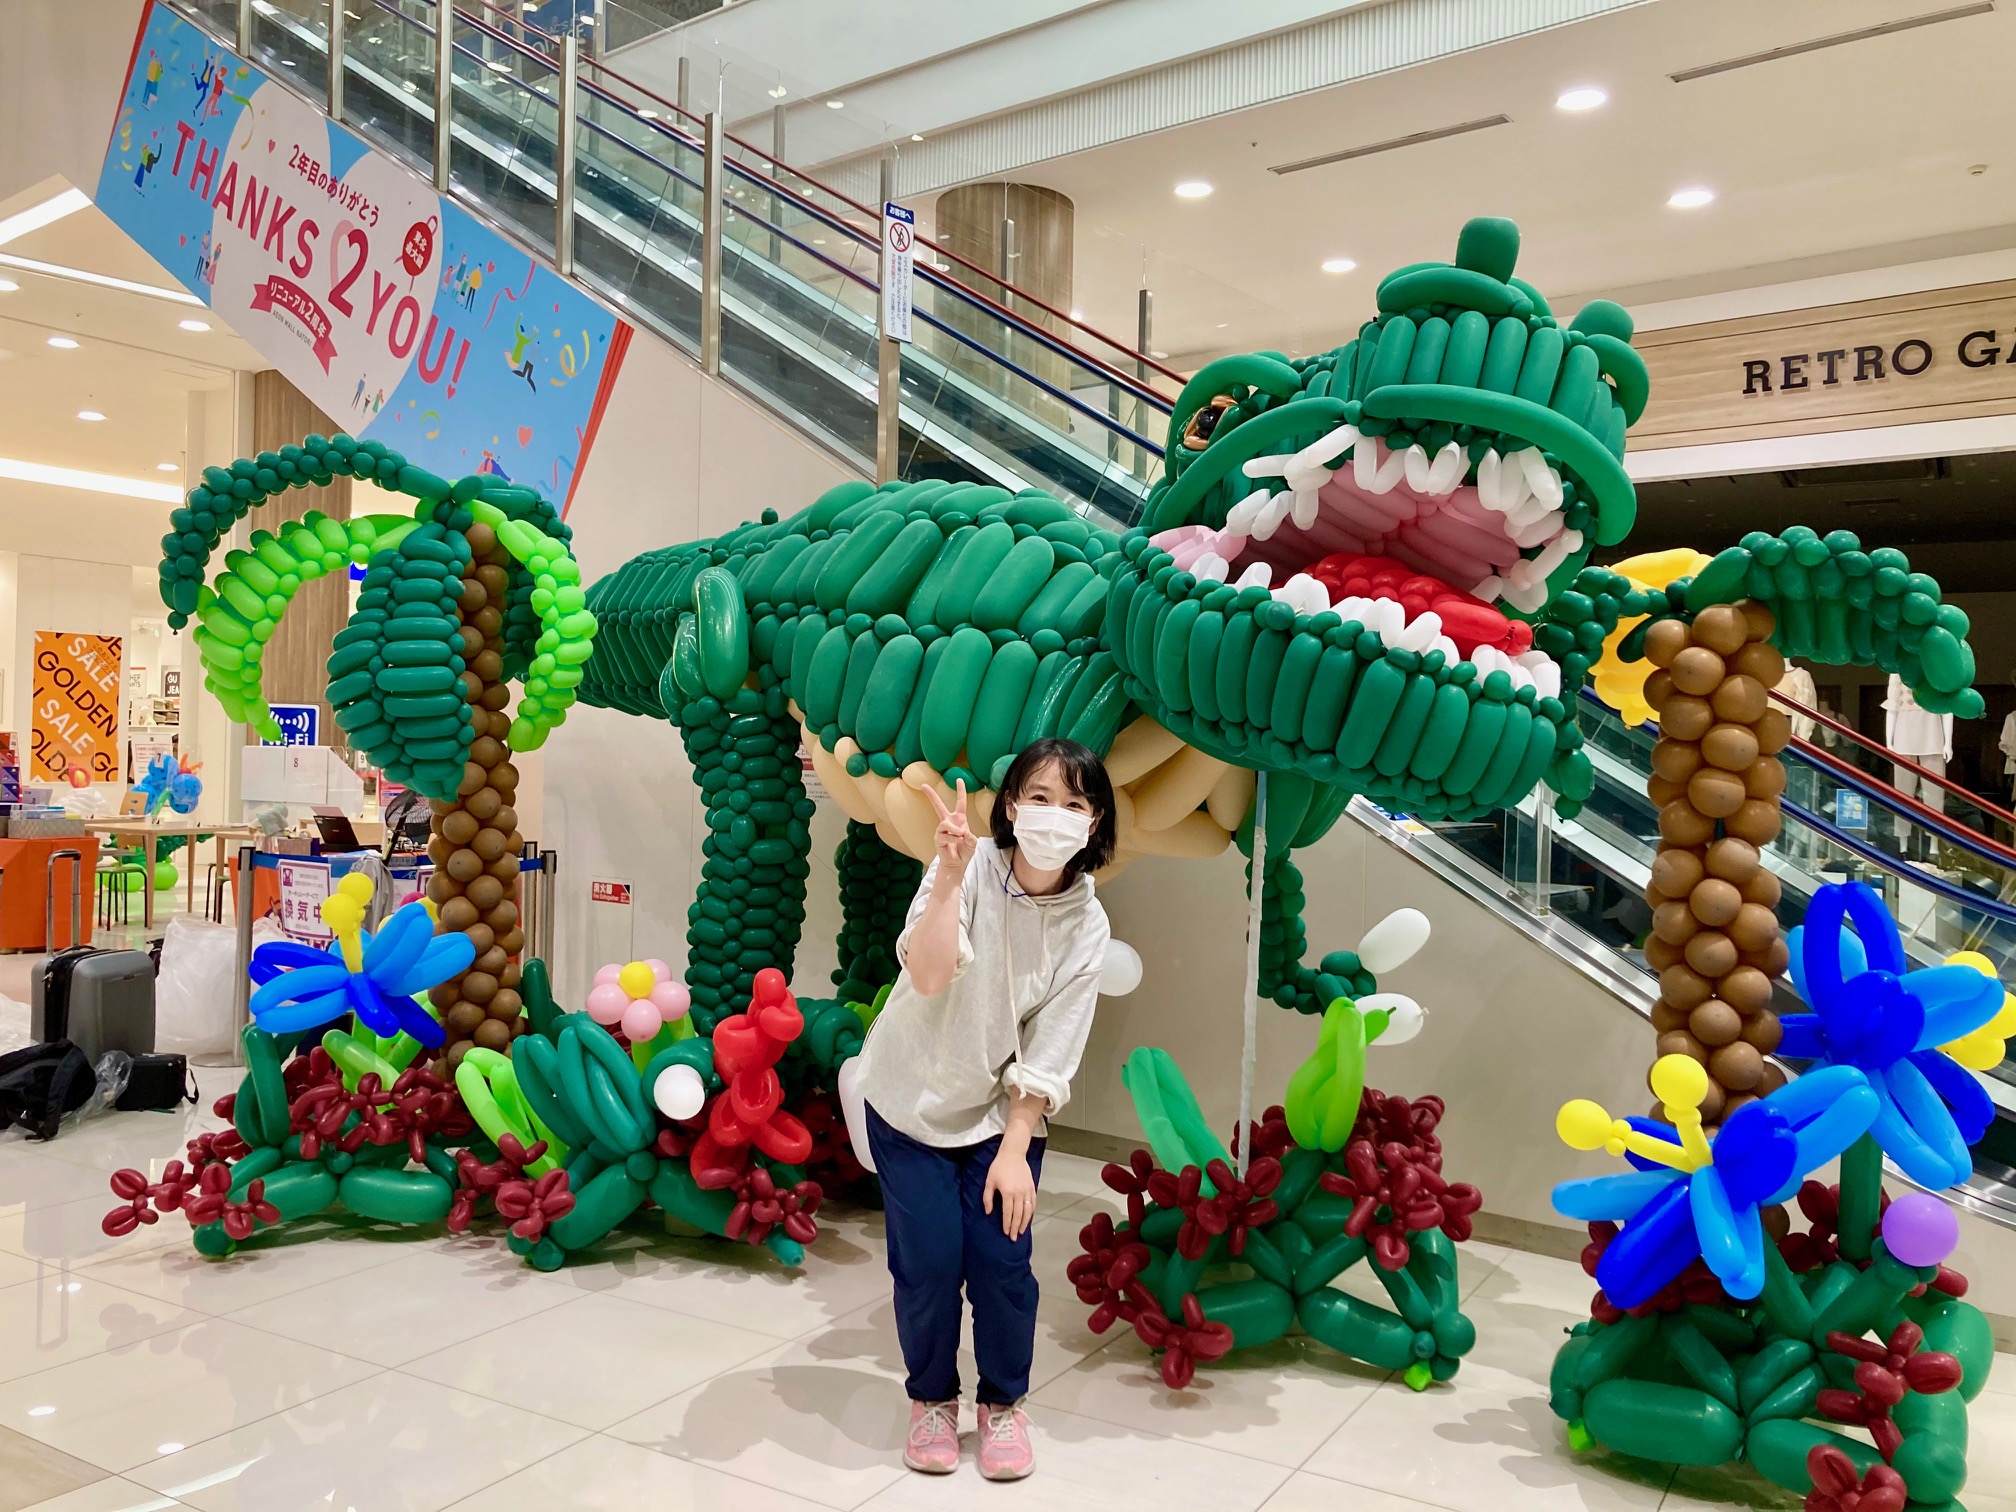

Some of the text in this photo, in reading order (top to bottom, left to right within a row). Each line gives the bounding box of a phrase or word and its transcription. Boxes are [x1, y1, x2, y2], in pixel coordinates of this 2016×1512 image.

[288, 144, 380, 228] 2年目のありがとう
[172, 120, 472, 400] THANKS 2 YOU!
[270, 281, 327, 338] リニューアル2周年
[284, 319, 297, 334] MALL
[1742, 329, 2016, 395] RETRO G
[67, 637, 120, 693] SALE
[167, 674, 178, 684] GU
[37, 650, 118, 738] GOLDEN
[39, 699, 95, 755] SALE
[157, 753, 162, 763] 7
[293, 757, 299, 768] 8
[360, 754, 365, 763] 9
